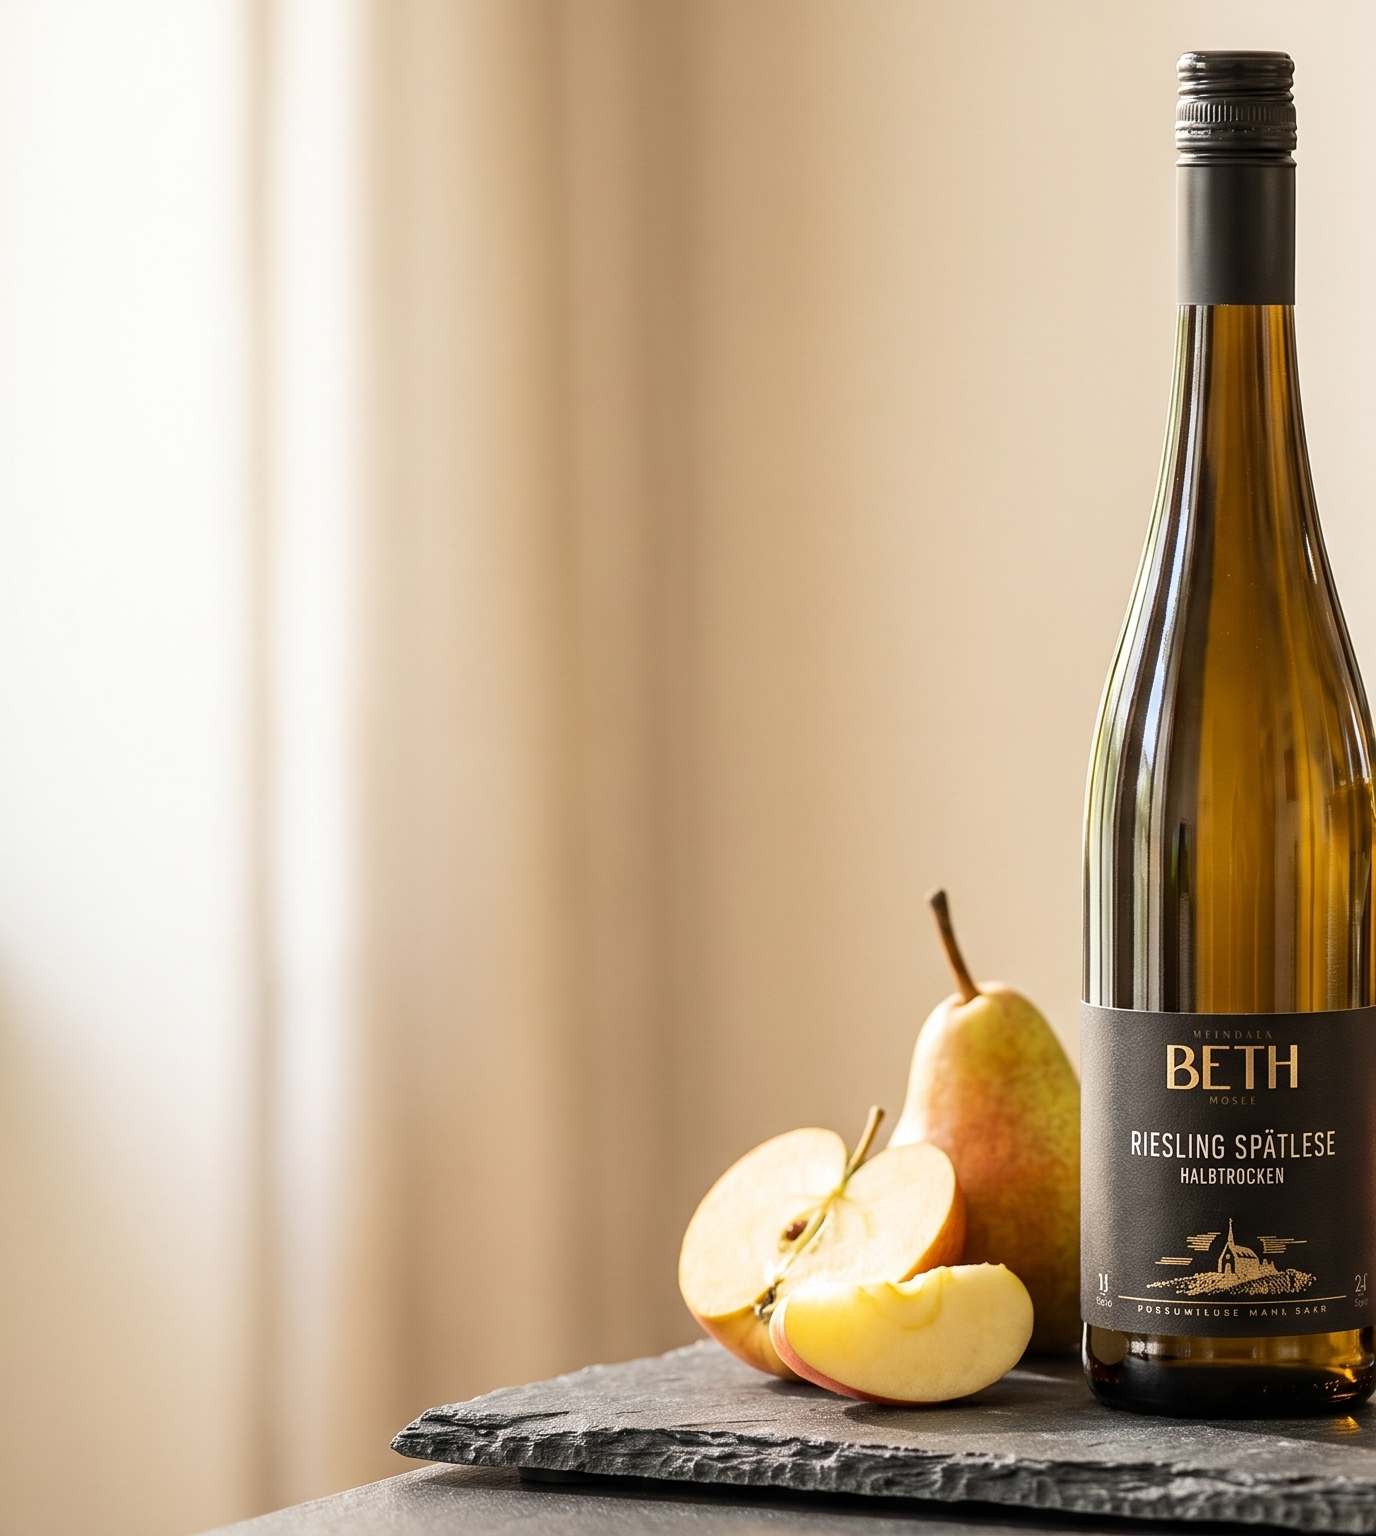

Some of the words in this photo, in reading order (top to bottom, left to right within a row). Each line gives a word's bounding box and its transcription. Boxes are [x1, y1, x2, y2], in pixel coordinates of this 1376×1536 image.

[1166, 1044, 1299, 1090] BETH
[1131, 1130, 1225, 1160] RIESLING
[1235, 1128, 1336, 1160] SPÄTLESE
[1180, 1167, 1284, 1185] HALBTROCKEN
